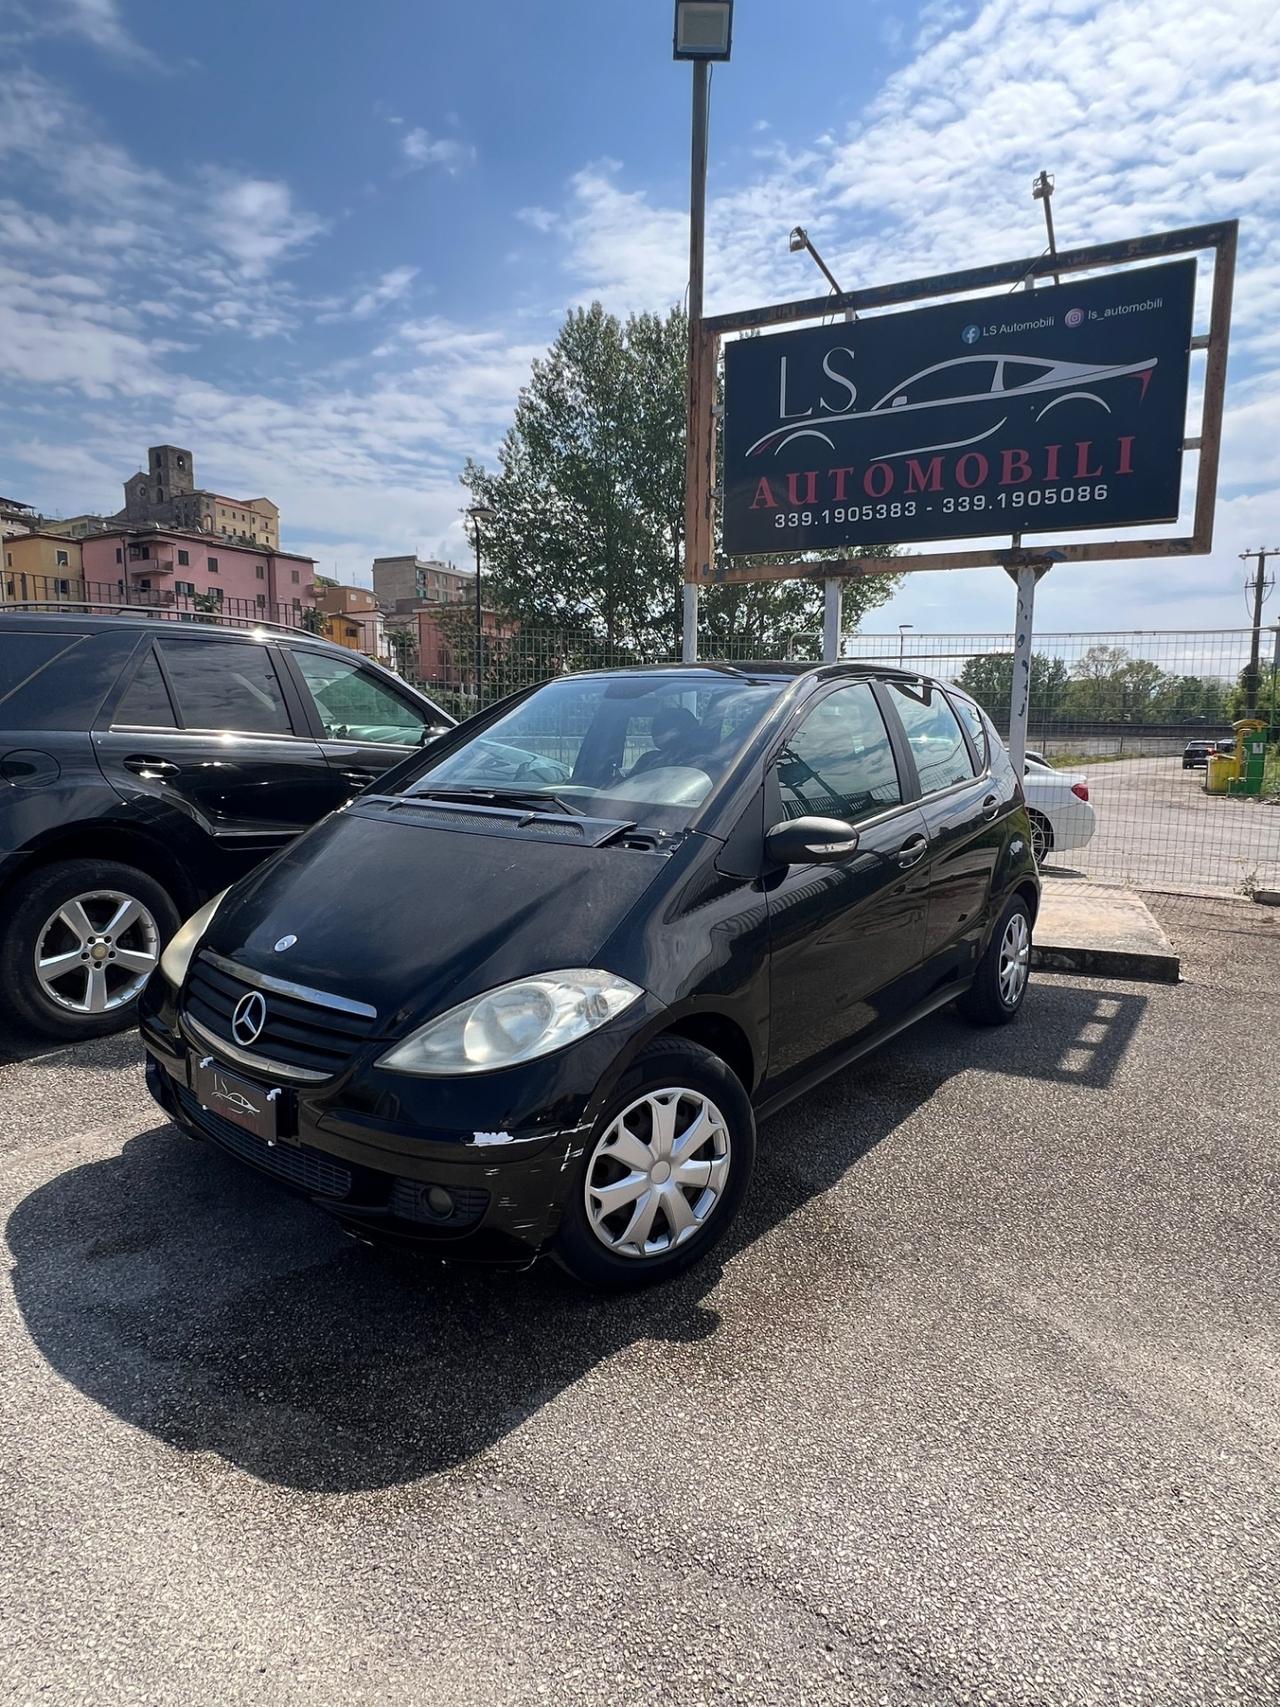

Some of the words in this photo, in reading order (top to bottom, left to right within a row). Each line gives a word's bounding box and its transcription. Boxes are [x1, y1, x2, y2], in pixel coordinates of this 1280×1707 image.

[983, 325, 997, 337] LS
[999, 316, 1055, 335] Automobili
[1088, 297, 1163, 321] ls_automobili
[780, 346, 857, 419] LS
[749, 437, 1136, 510] AUTOMOBILI
[774, 501, 917, 529] 339.1905383
[942, 484, 1108, 513] 339.1905086
